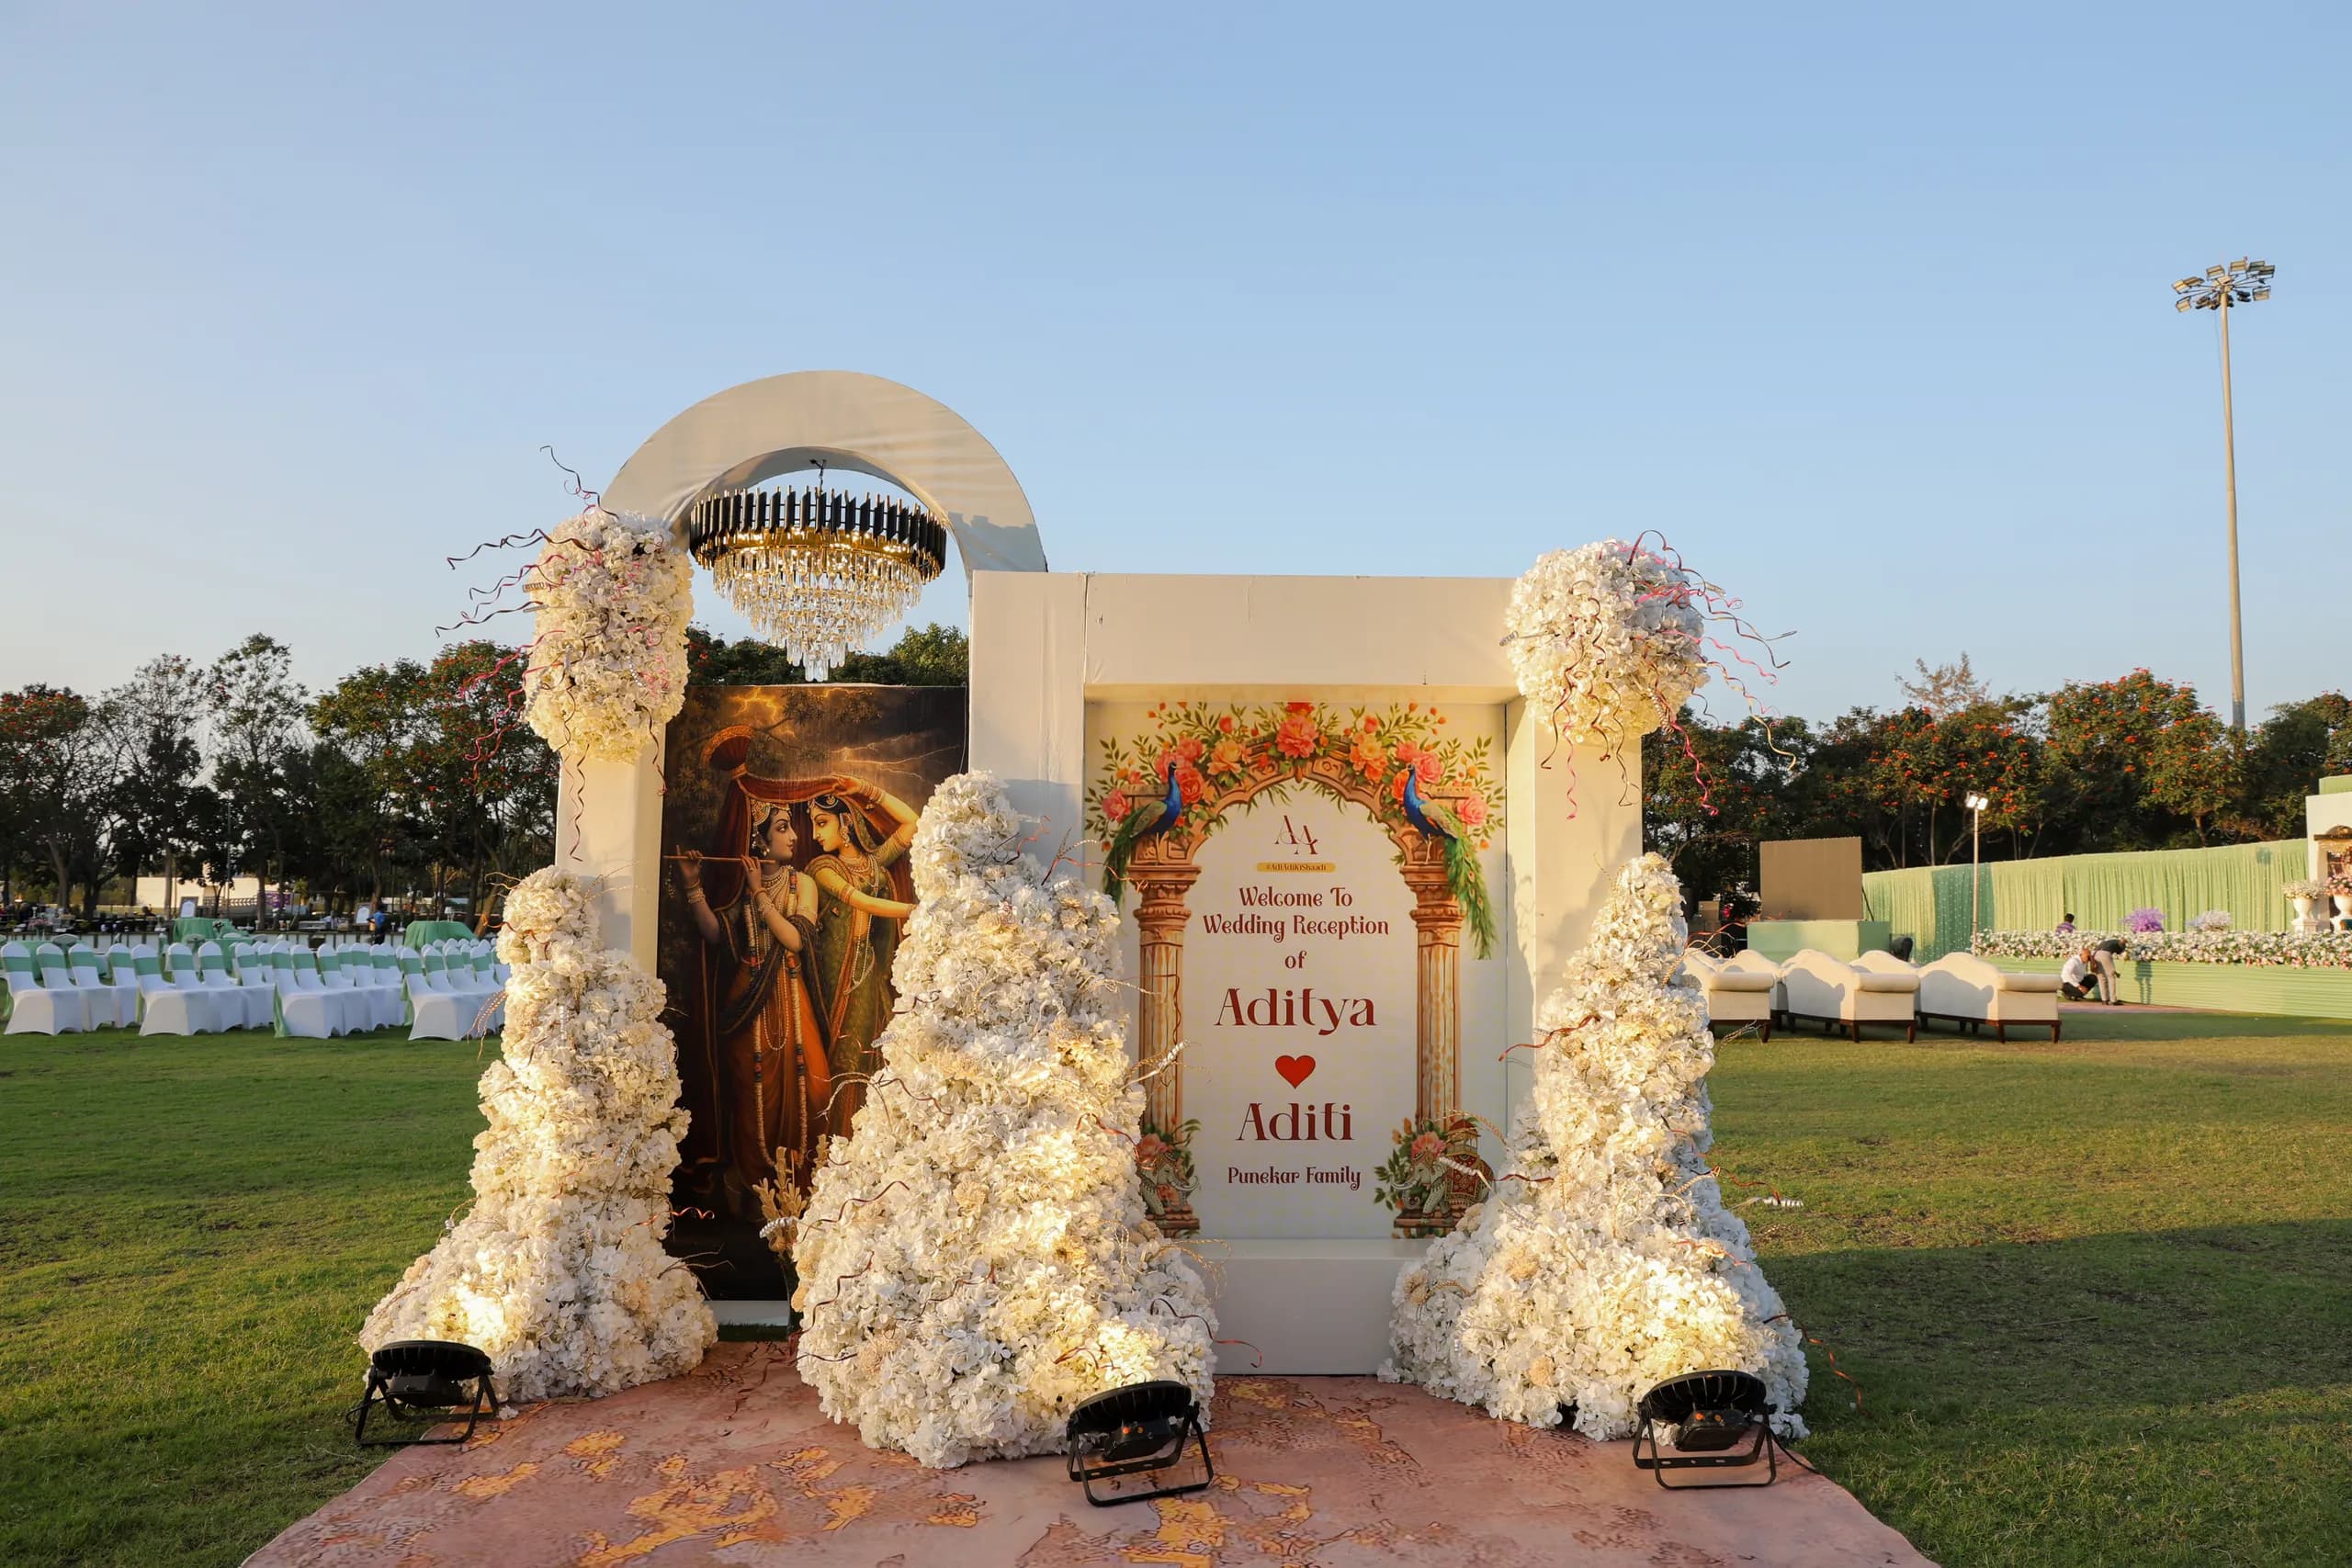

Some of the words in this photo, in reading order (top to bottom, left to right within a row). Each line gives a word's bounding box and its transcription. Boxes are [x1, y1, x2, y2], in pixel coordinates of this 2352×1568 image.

[1238, 886, 1323, 908] Welcome
[1329, 886, 1353, 907] To
[1203, 913, 1285, 942] Wedding
[1293, 915, 1389, 940] Reception
[1284, 950, 1306, 969] of
[1214, 988, 1377, 1035] Aditya
[1236, 1103, 1354, 1140] Aditi
[1227, 1166, 1300, 1184] Punekar
[1306, 1166, 1362, 1190] Family
